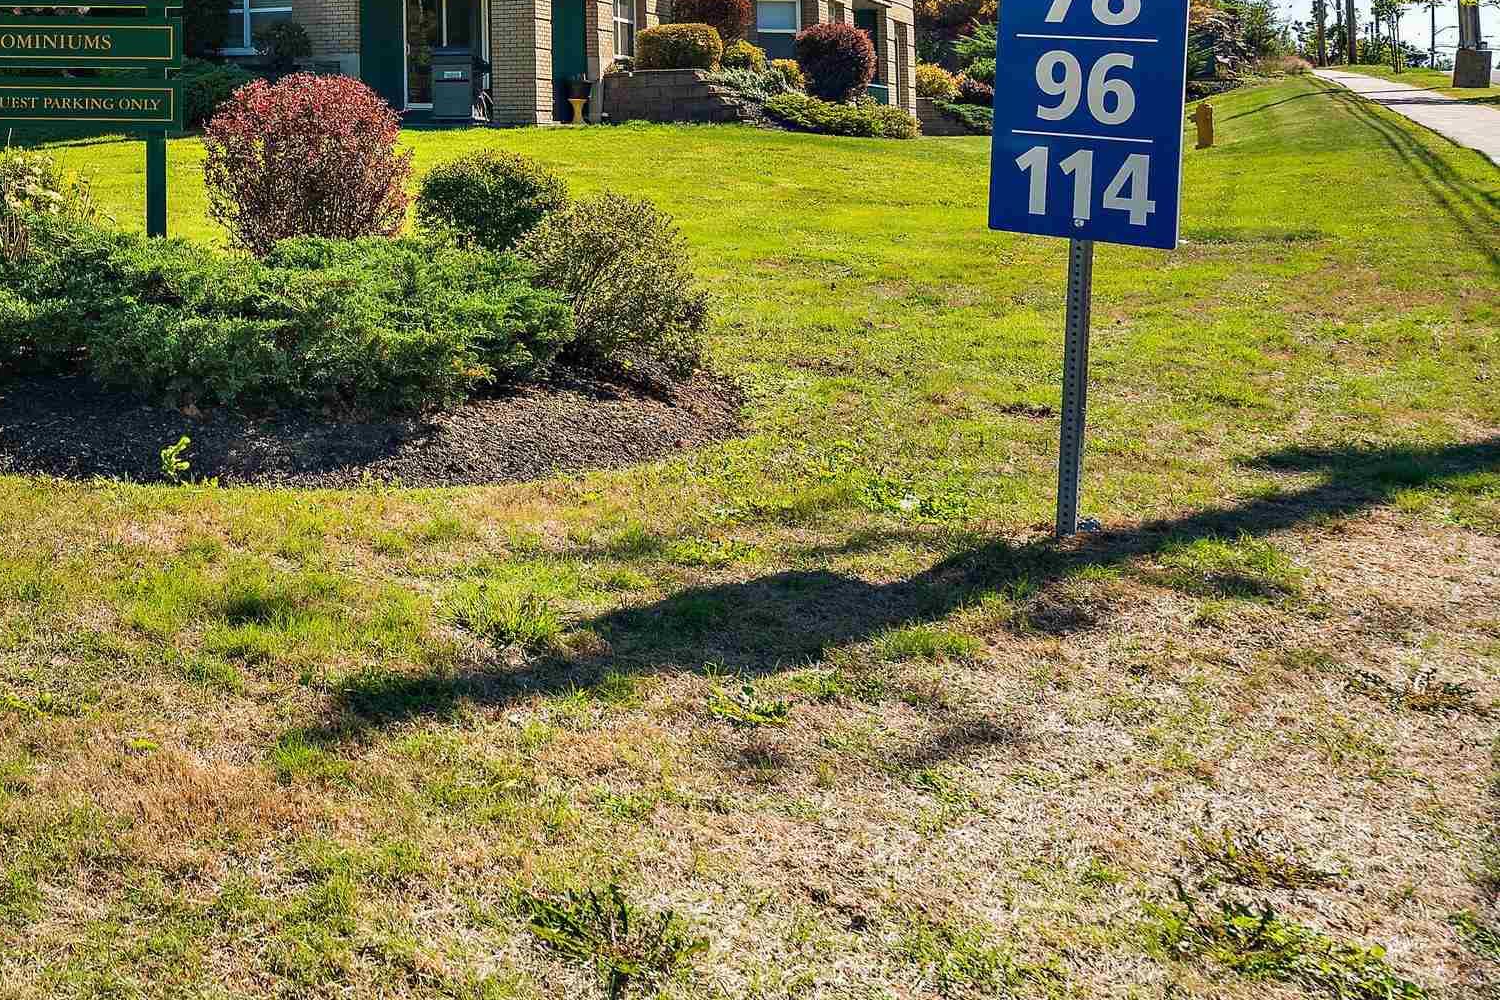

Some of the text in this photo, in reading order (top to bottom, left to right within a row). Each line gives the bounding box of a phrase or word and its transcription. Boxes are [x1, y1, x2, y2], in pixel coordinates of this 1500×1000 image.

[43, 96, 116, 111] PARKING
[117, 97, 162, 112] ONLY
[1034, 49, 1136, 126] 96
[1014, 144, 1157, 227] 114
